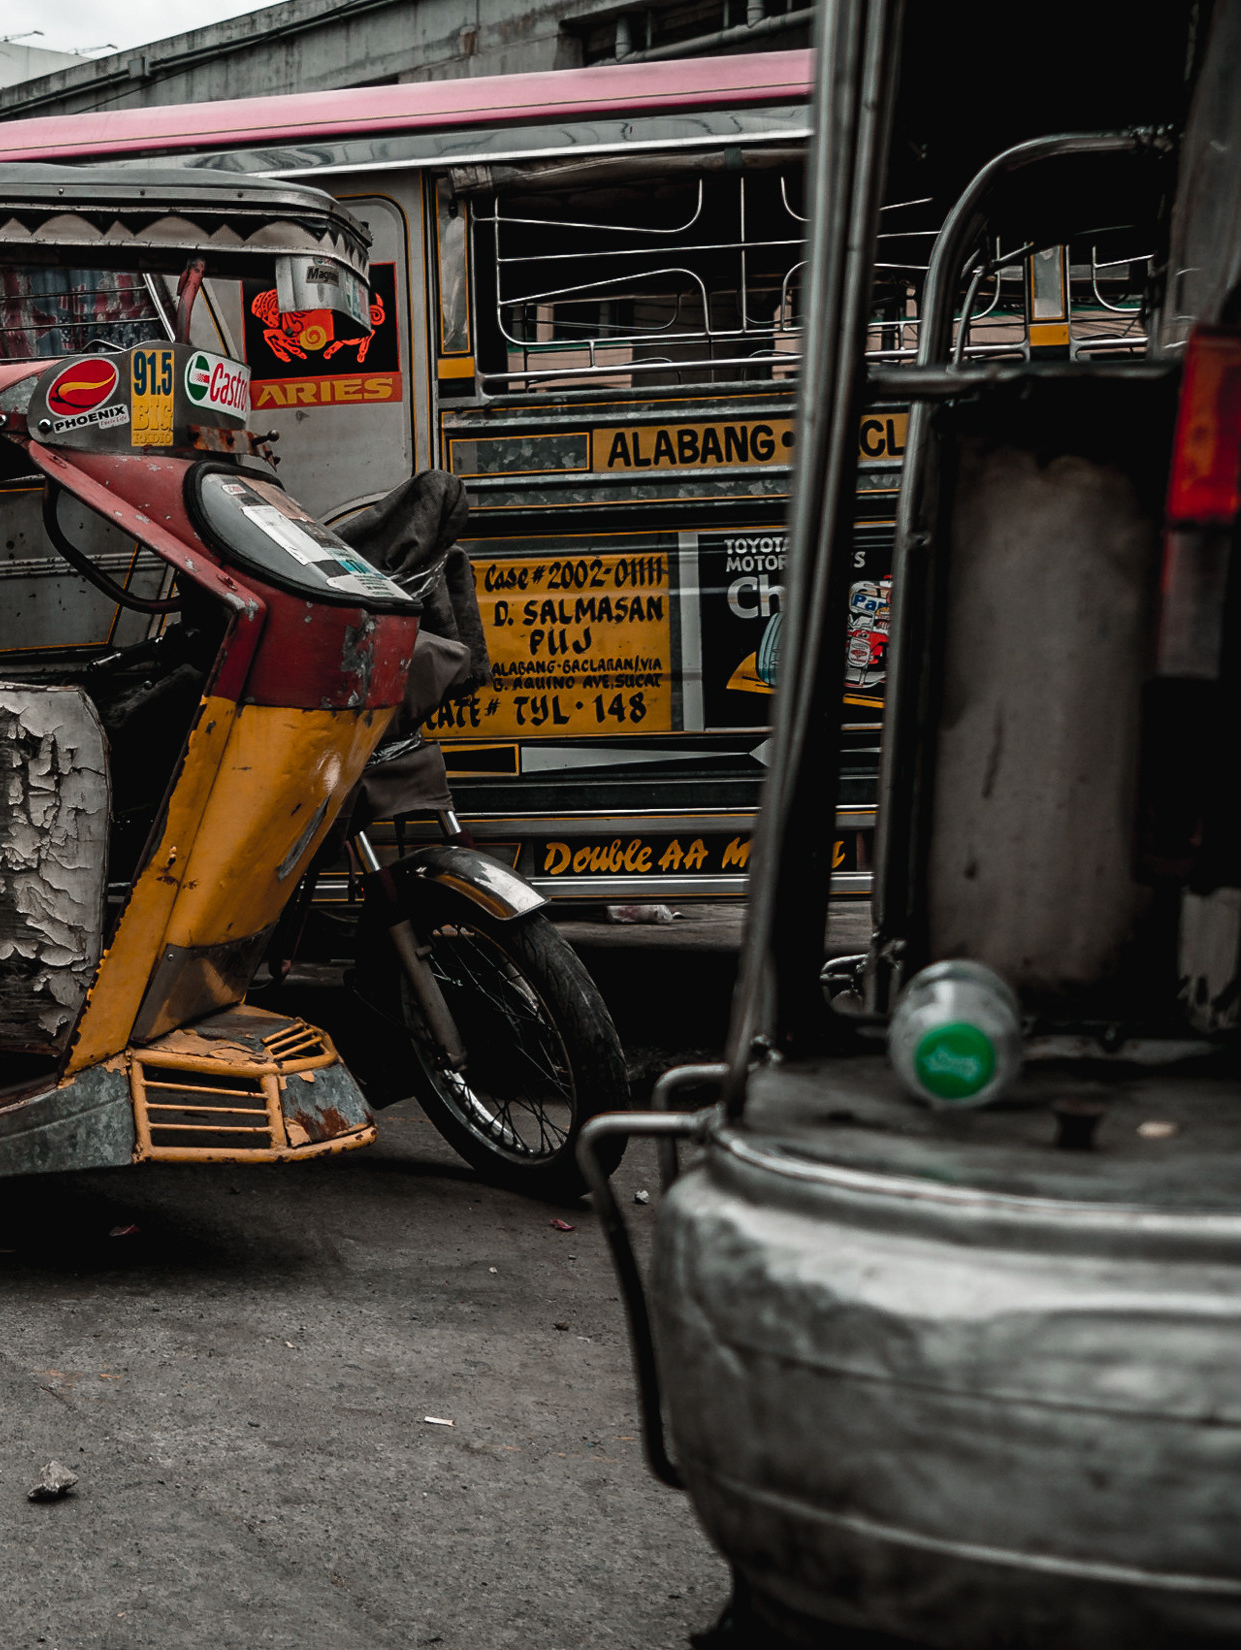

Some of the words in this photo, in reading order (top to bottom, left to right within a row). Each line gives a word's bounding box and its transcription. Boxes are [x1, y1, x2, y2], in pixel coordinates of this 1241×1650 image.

[133, 351, 172, 396] 91.5
[257, 378, 393, 407] ARIES
[54, 405, 126, 432] PHOENIX
[133, 404, 172, 431] BIG
[608, 425, 775, 467] ALABANG
[493, 600, 514, 627] D.
[522, 596, 664, 626] SALMASAN
[512, 676, 576, 691] AQUINO
[513, 694, 571, 726] TYL
[593, 691, 647, 724] 148
[544, 838, 652, 875] Double
[658, 838, 708, 871] AA
